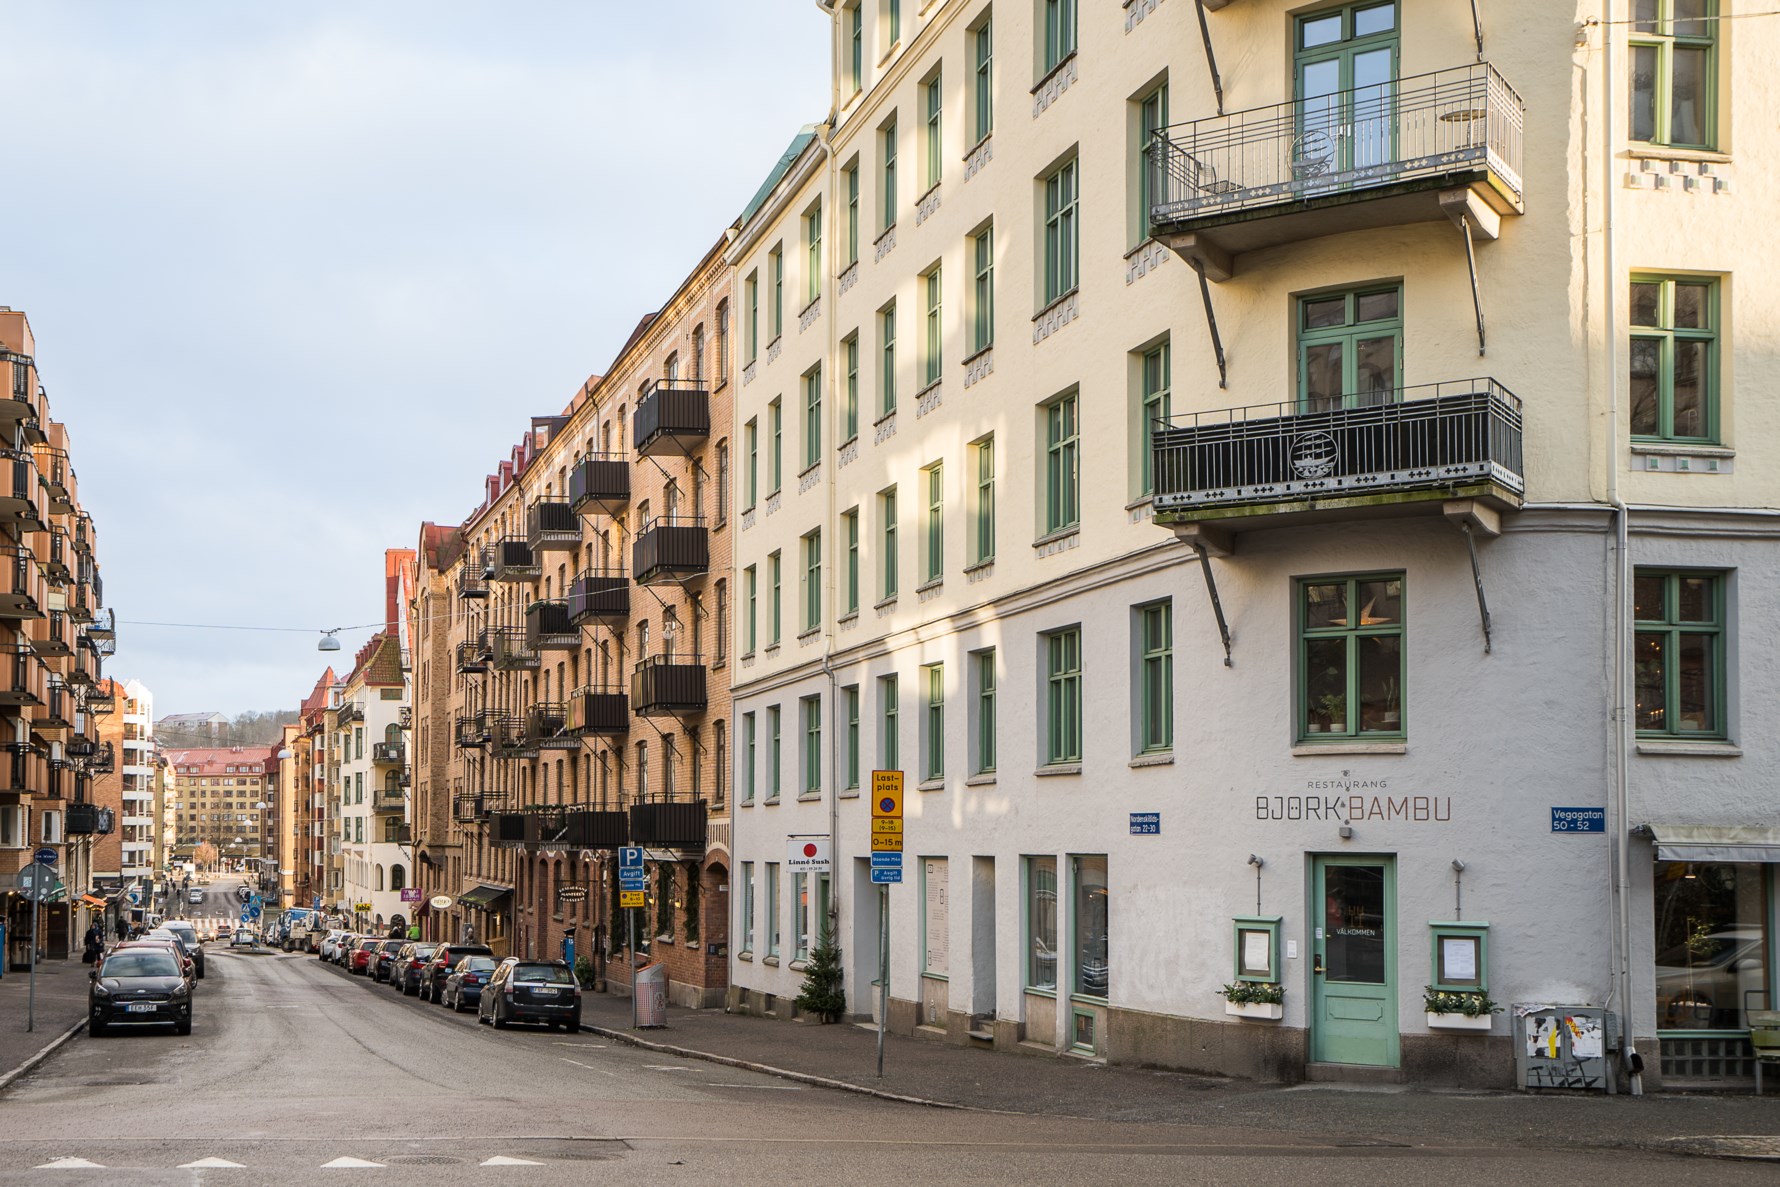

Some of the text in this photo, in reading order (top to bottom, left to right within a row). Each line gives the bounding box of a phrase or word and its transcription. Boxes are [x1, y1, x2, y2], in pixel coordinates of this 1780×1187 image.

[876, 774, 899, 782] Last-
[877, 784, 899, 792] plats
[1307, 780, 1387, 789] RESTAURANG
[1256, 796, 1451, 822] BJÖRK BAMBU
[1553, 810, 1603, 821] Vegagatan
[1142, 824, 1156, 832] 22-30
[1553, 821, 1568, 830] 50
[1577, 821, 1589, 830] 52
[626, 849, 638, 866] P
[1336, 928, 1376, 936] VÄLKOMMEN
